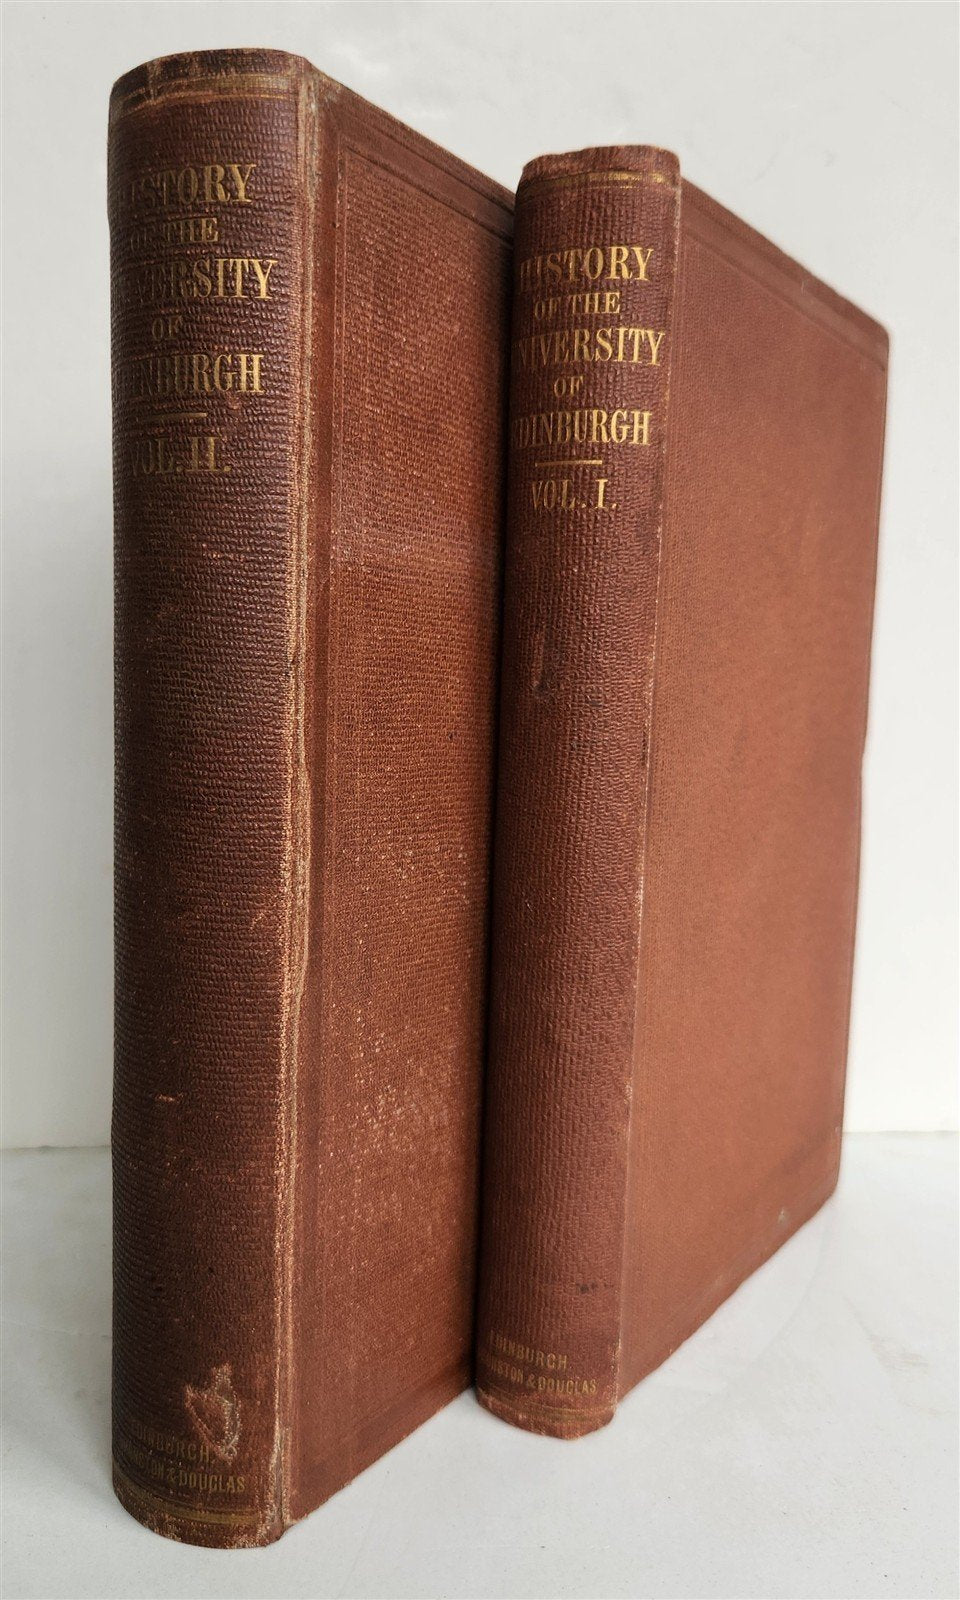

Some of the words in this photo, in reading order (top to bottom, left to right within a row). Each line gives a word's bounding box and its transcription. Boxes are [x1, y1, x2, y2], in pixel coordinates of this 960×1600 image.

[120, 163, 257, 206] ISTORY
[163, 217, 219, 246] THE
[534, 296, 562, 321] OF
[565, 291, 621, 316] THE
[151, 315, 183, 342] OF
[513, 327, 665, 369] NIVERSITY
[554, 375, 584, 398] OF
[531, 478, 588, 511] VOL.
[595, 478, 619, 509] I.
[526, 1373, 537, 1389] &
[178, 1469, 246, 1494] DOUGLAS
